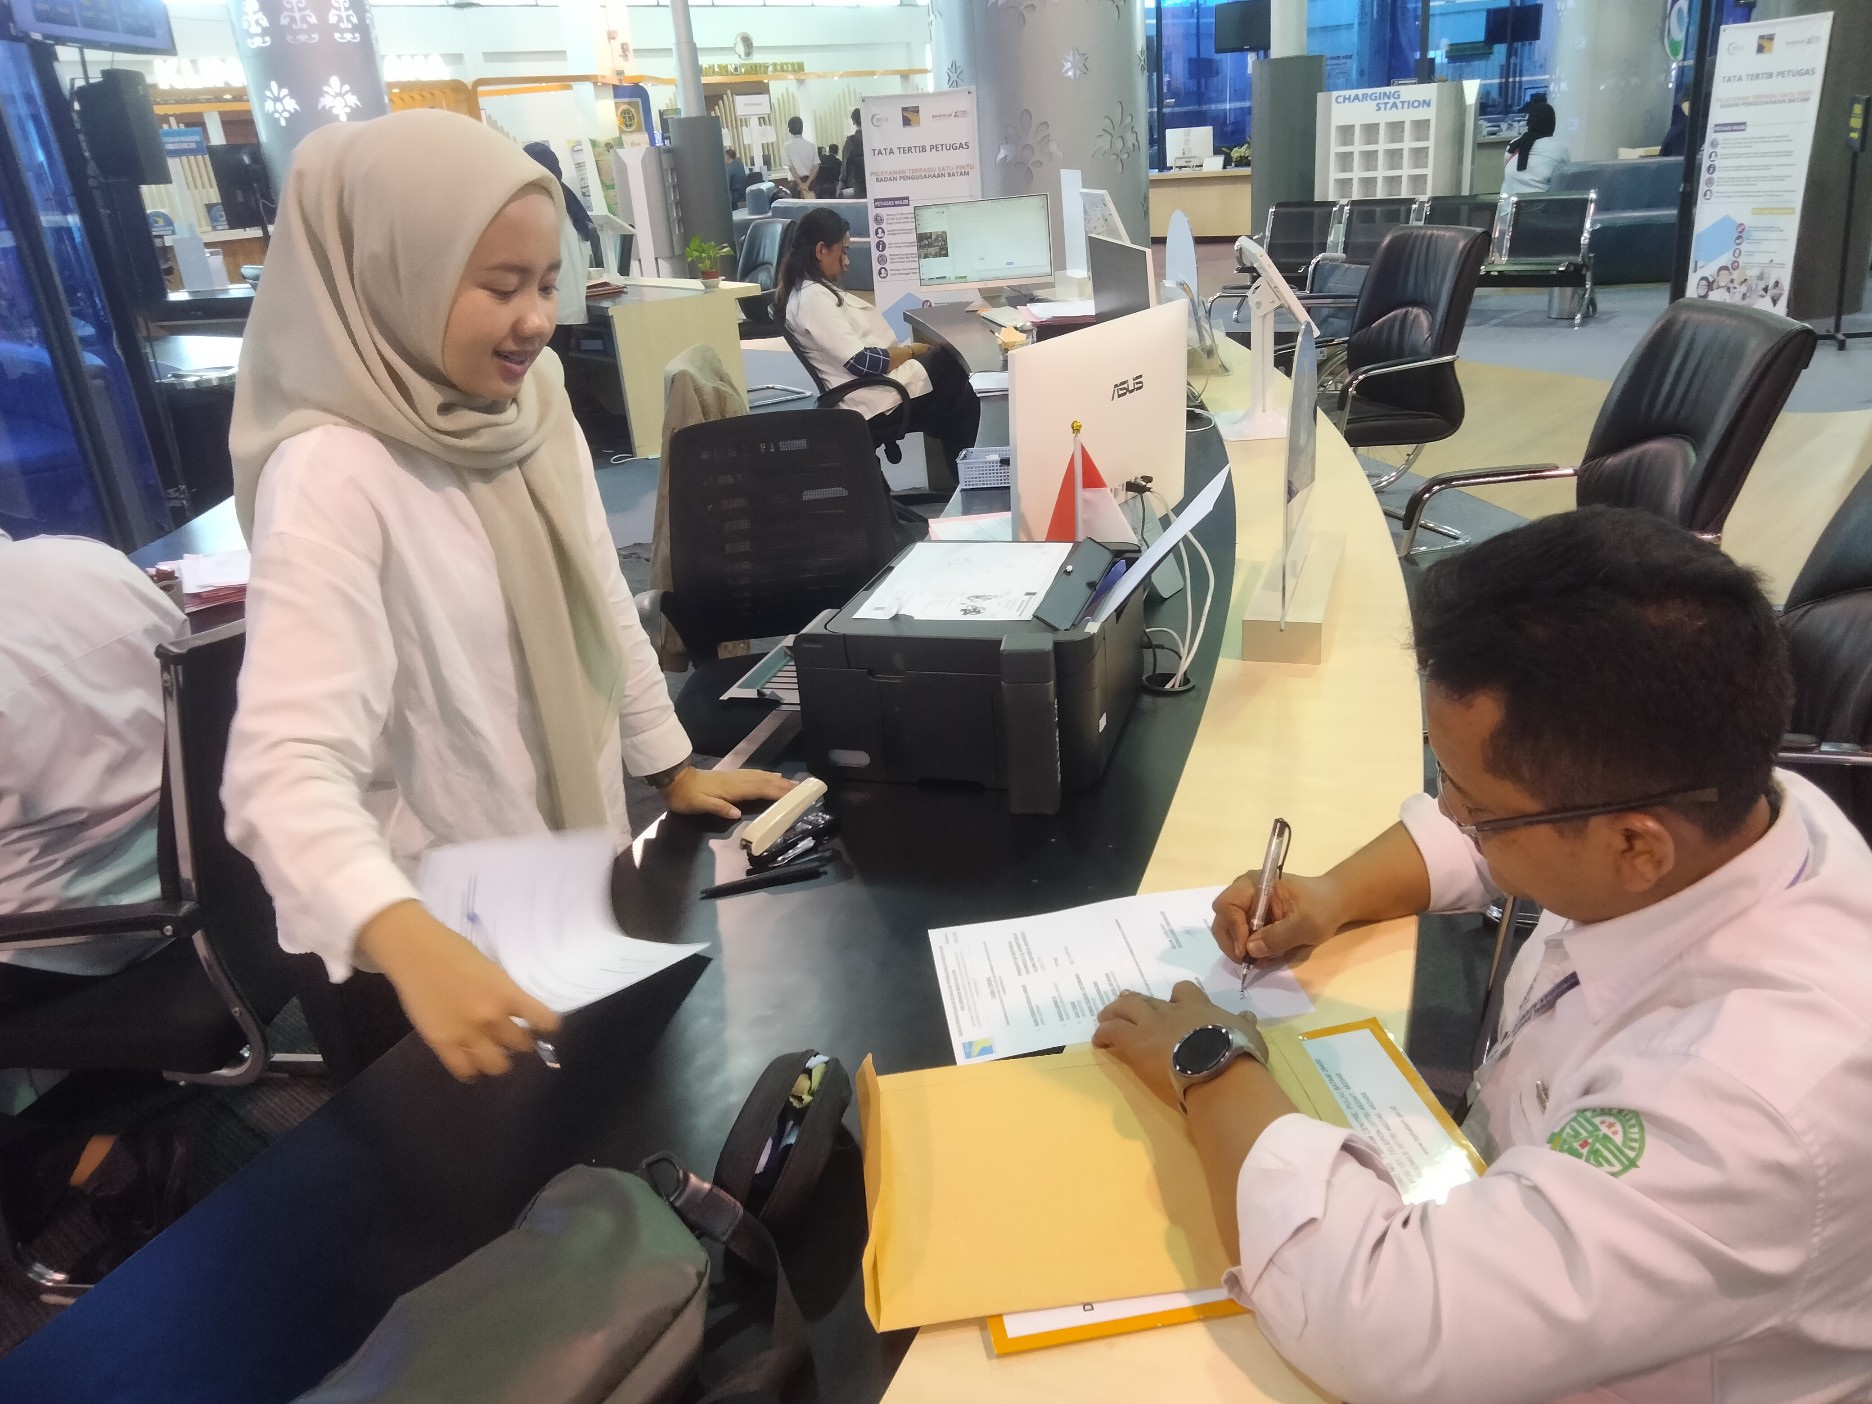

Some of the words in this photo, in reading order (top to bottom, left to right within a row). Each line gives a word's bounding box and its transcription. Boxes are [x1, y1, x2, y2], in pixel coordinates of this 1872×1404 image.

[1722, 75, 1743, 84] TATA
[1745, 71, 1774, 82] TERTIB
[1776, 67, 1816, 79] PETUGAS
[1335, 91, 1400, 104] CHARGING
[1376, 98, 1431, 112] STATION
[871, 148, 895, 157] TATA
[897, 145, 927, 155] TERTIB
[929, 141, 970, 153] PETUGAS
[870, 168, 907, 177] PELAYANAN
[908, 166, 937, 175] TERPADU
[955, 163, 975, 171] PINTU
[875, 174, 898, 183] BADAN
[899, 172, 946, 181] PENGUSAHAAN
[947, 170, 970, 178] BATAM
[1111, 374, 1144, 401] ASUS
[1324, 1072, 1340, 1091] BATAM
